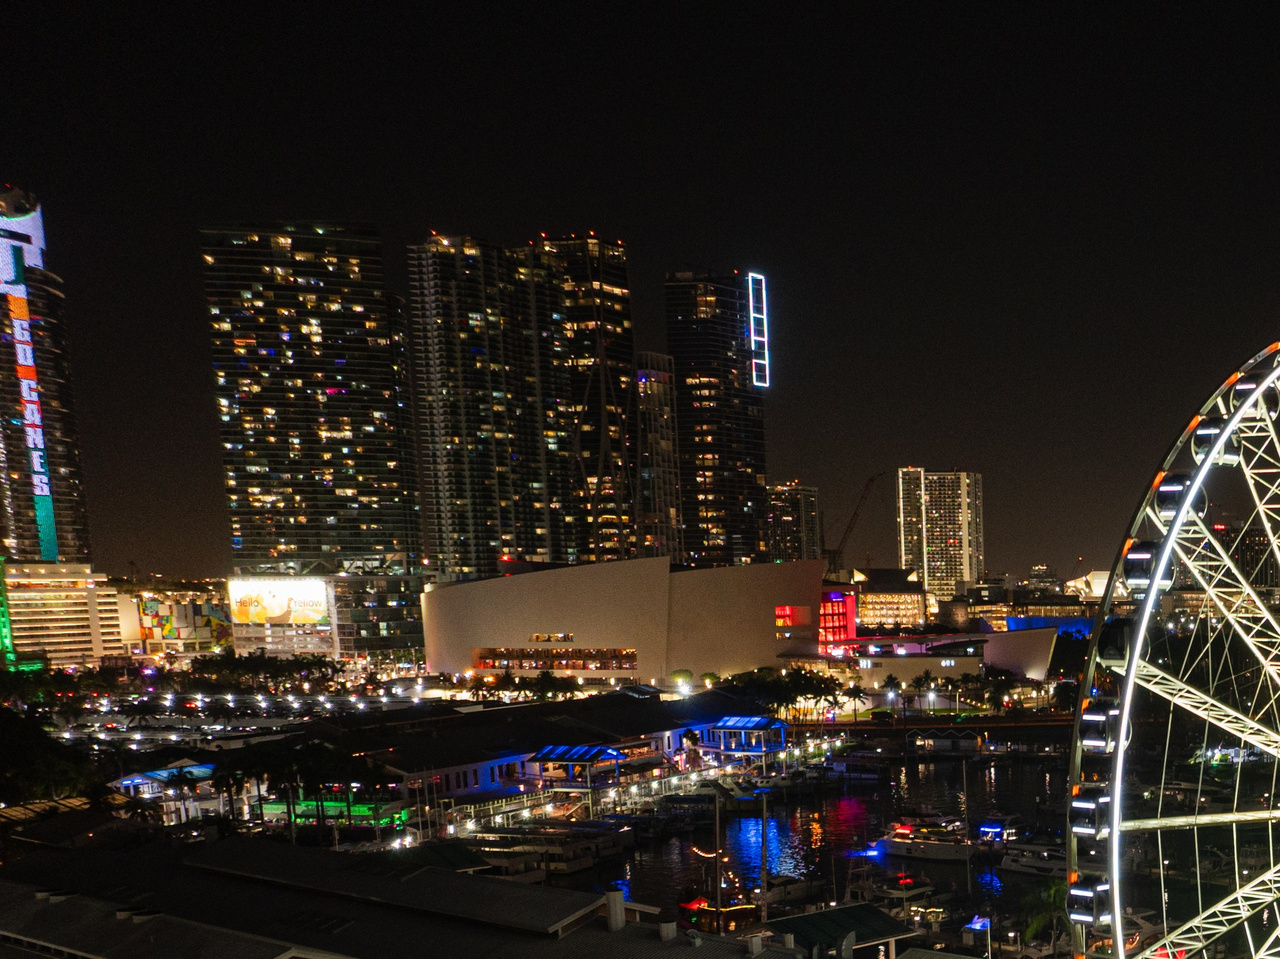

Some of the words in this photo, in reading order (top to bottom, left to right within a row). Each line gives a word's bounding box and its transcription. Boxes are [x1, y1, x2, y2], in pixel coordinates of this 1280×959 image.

[12, 319, 35, 366] GO
[20, 379, 51, 496] CANES
[235, 599, 259, 608] Hello
